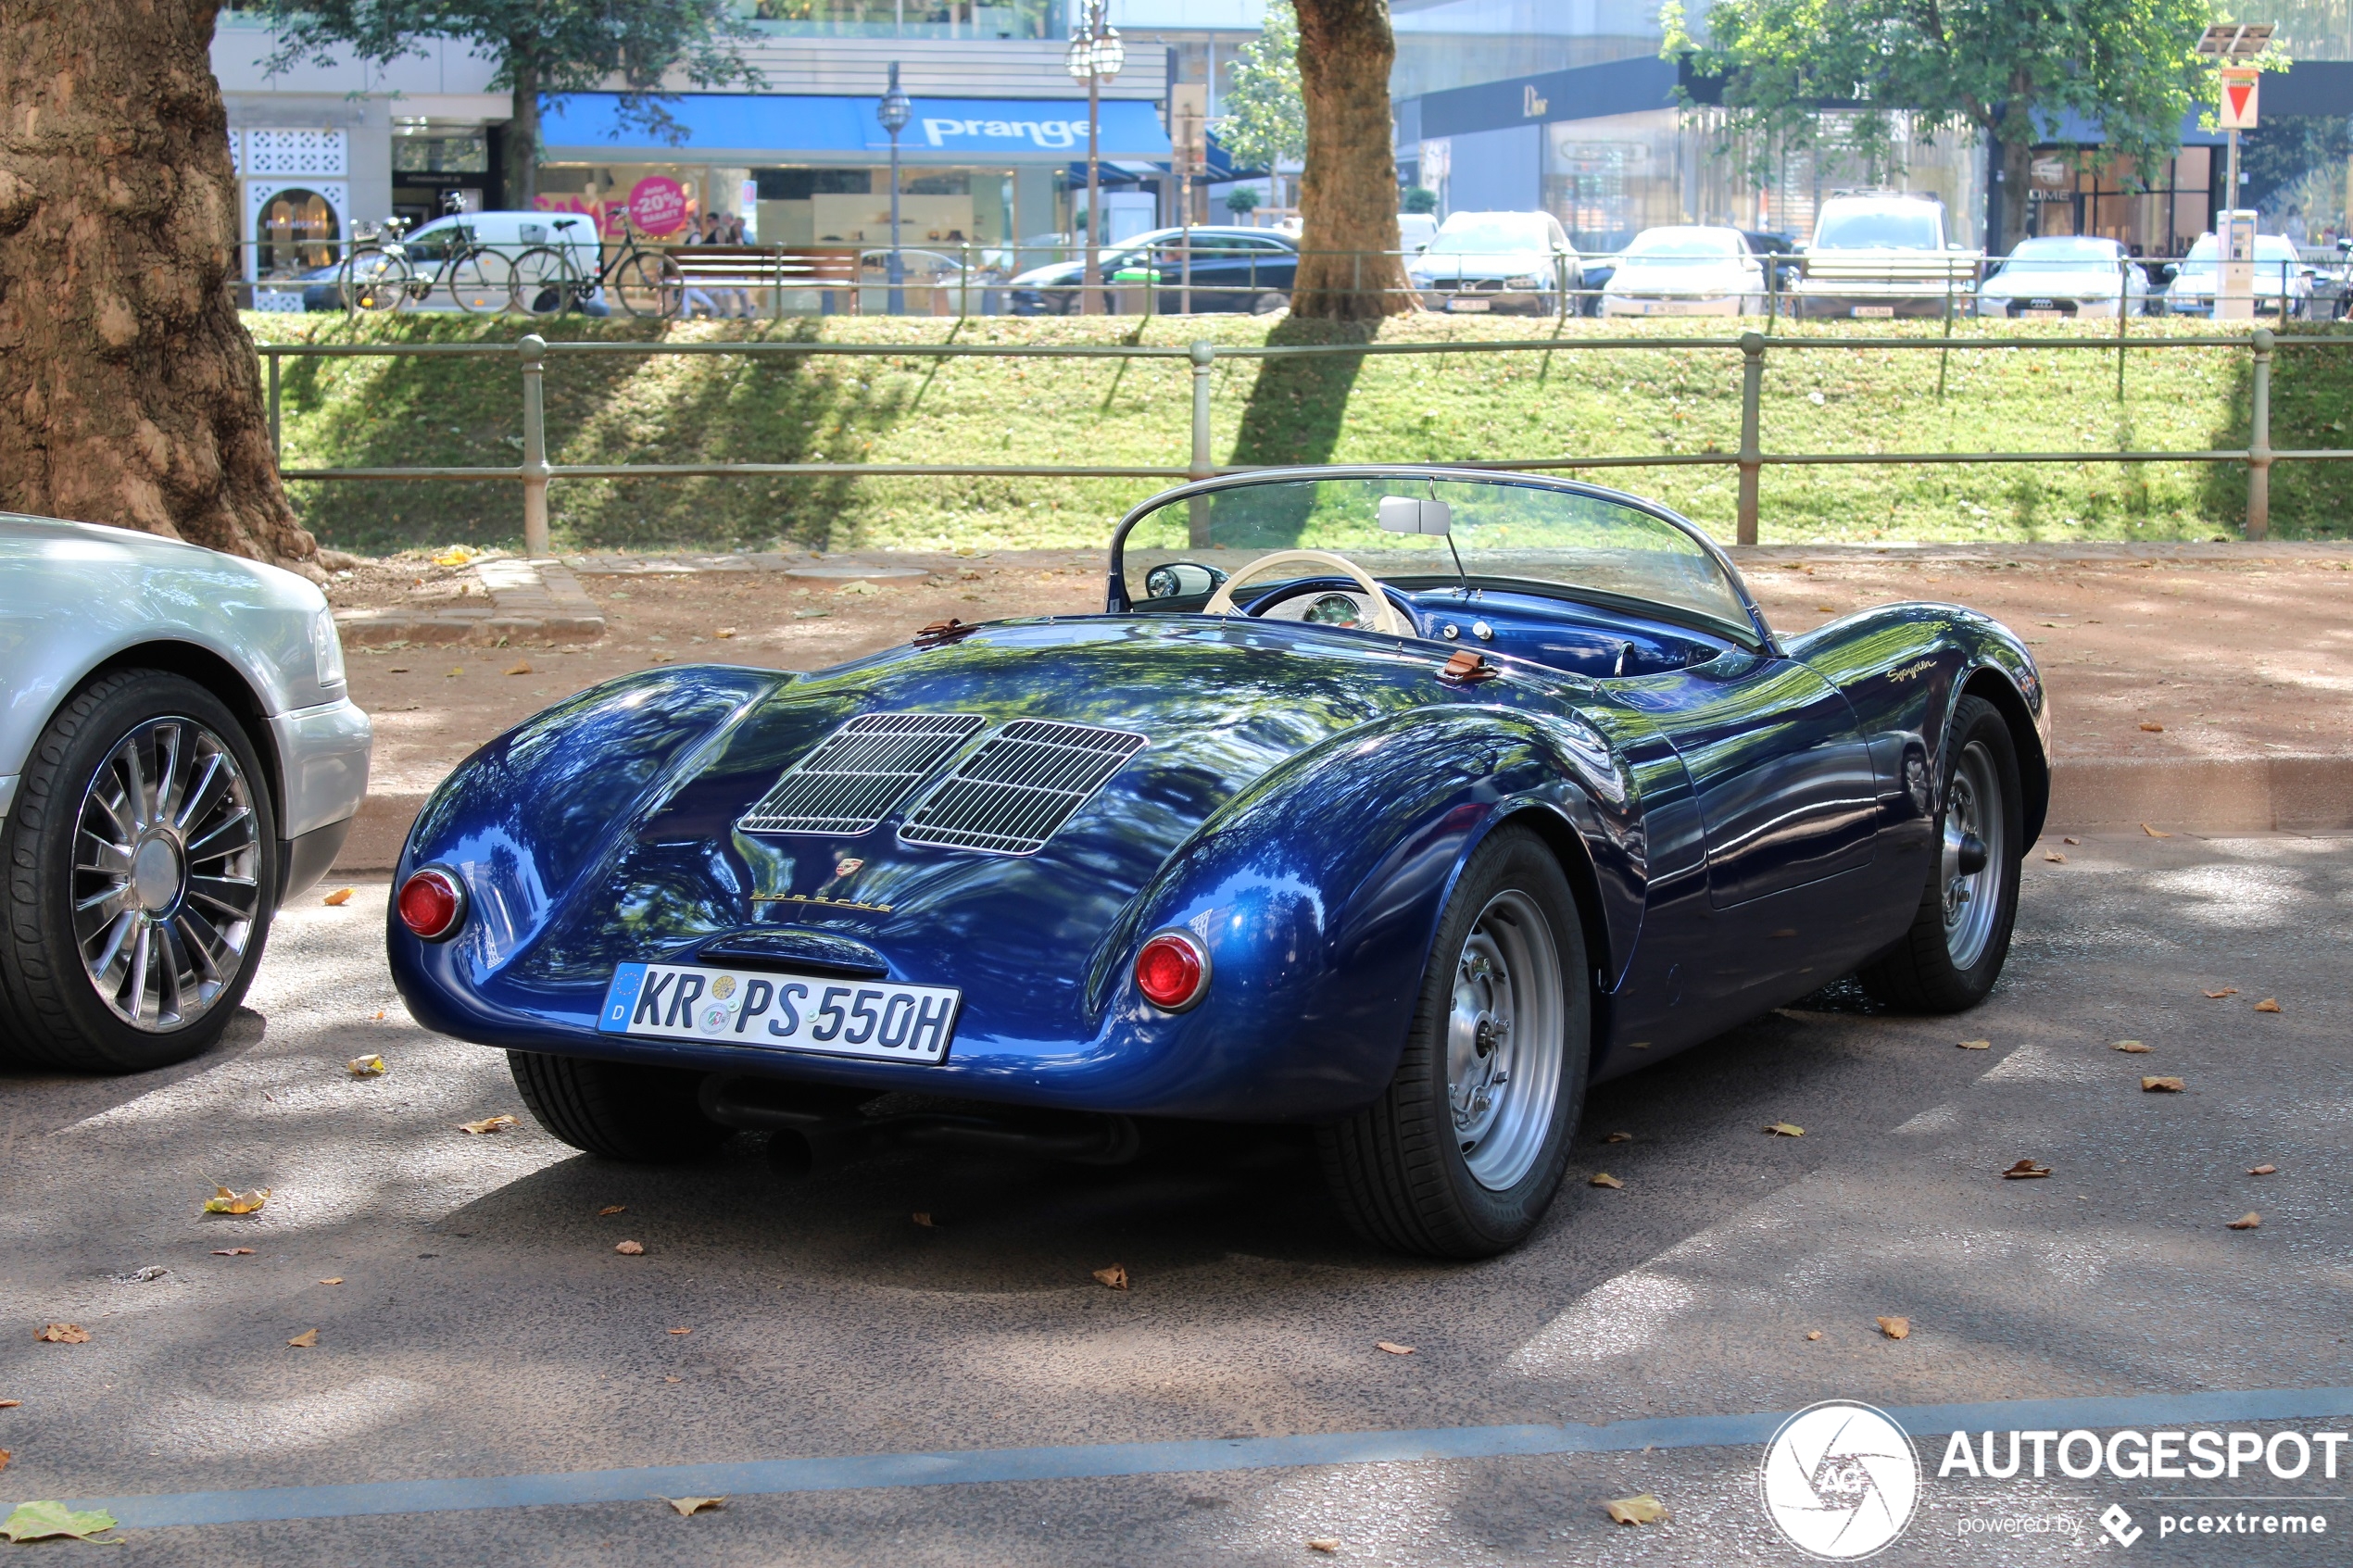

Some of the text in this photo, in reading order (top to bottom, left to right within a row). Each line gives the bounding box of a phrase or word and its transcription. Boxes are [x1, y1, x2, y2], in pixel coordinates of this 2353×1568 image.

[922, 118, 1101, 148] prange
[633, 191, 683, 213] -20%
[641, 208, 680, 223] RABATT
[1885, 660, 1937, 683] Spyder
[750, 893, 893, 912] PORSCHE
[611, 1005, 625, 1021] D
[633, 972, 706, 1028] KR
